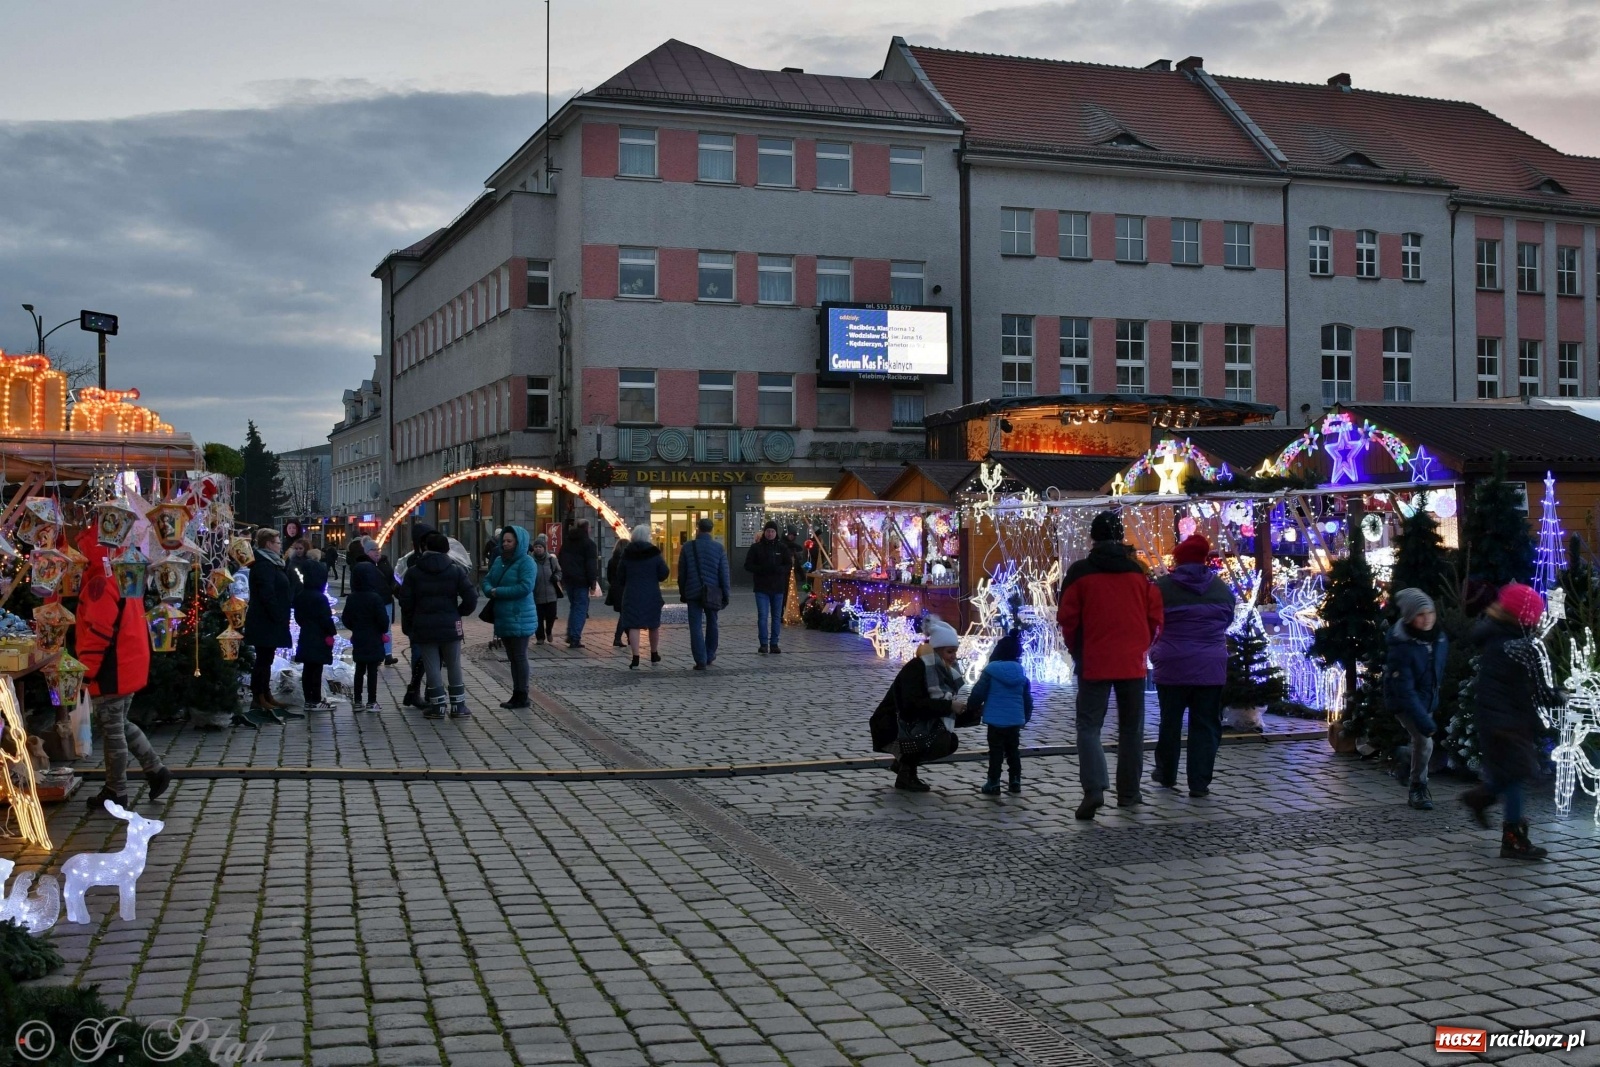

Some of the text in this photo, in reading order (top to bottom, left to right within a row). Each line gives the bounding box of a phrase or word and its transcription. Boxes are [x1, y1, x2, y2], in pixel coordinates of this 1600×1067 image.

[832, 353, 913, 371] Centrum Kas Fiskalnych
[618, 428, 795, 463] BOLKO
[636, 470, 746, 483] DELIKATESY
